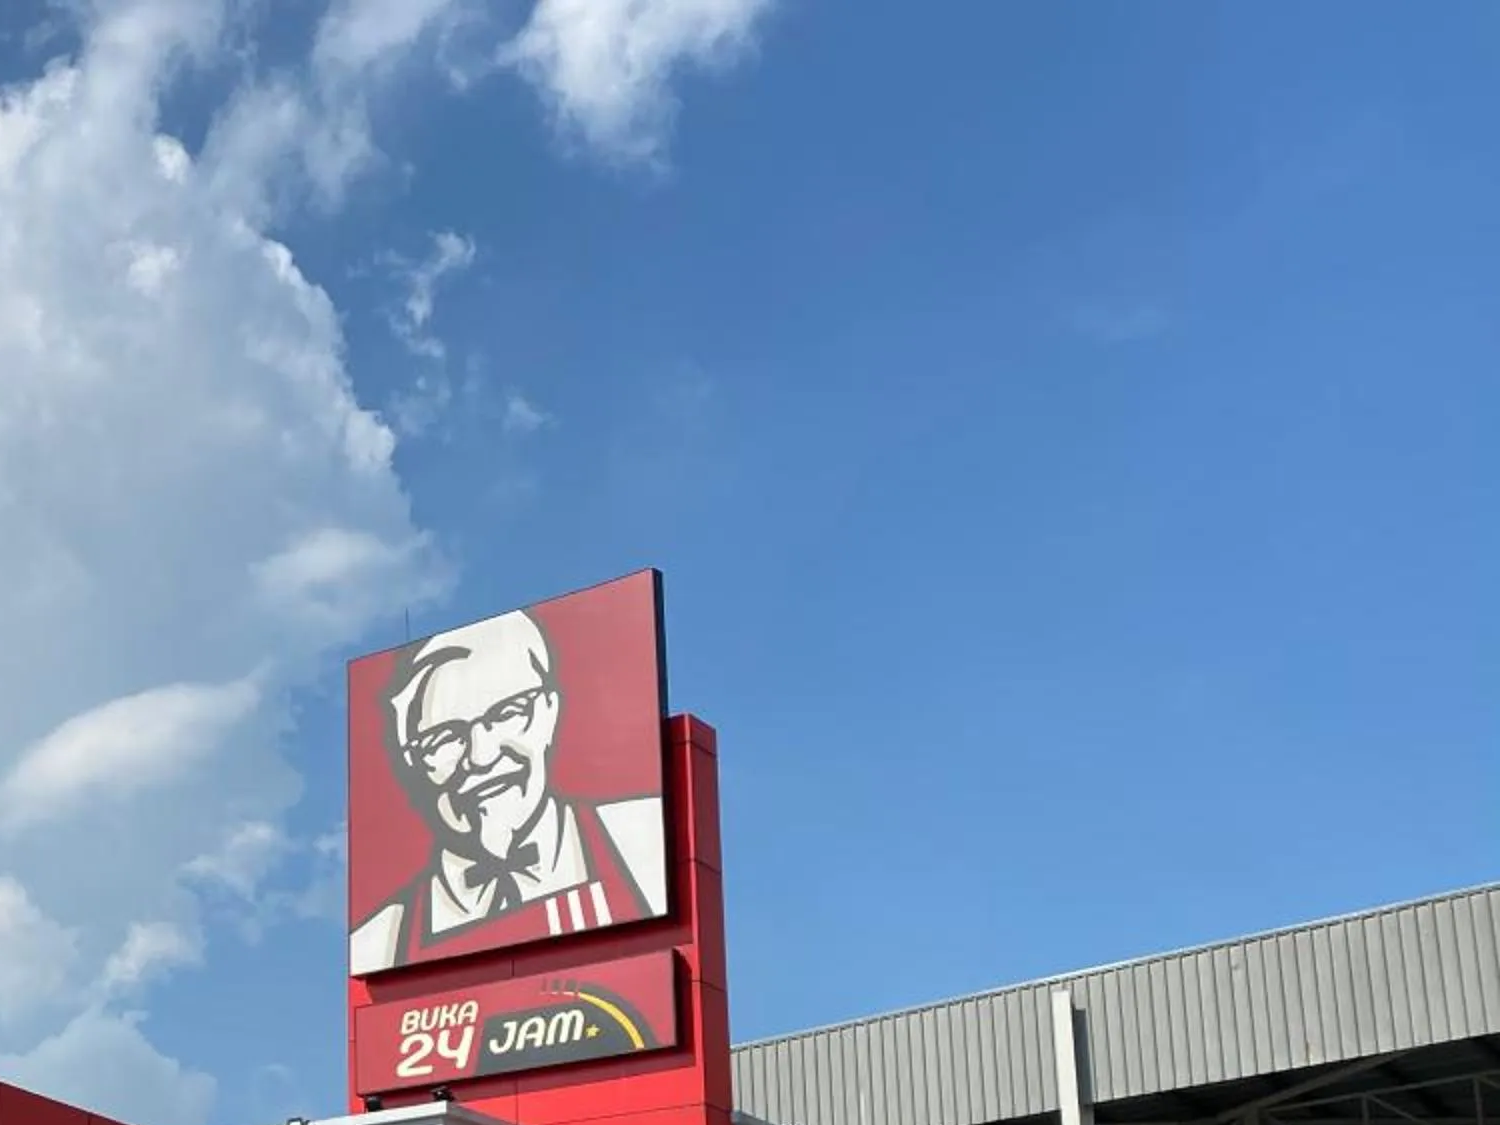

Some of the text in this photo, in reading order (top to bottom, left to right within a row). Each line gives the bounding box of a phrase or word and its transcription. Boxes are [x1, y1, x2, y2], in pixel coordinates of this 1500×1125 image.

[395, 1009, 586, 1078] 24 JAM
[400, 1000, 479, 1035] BUKA
